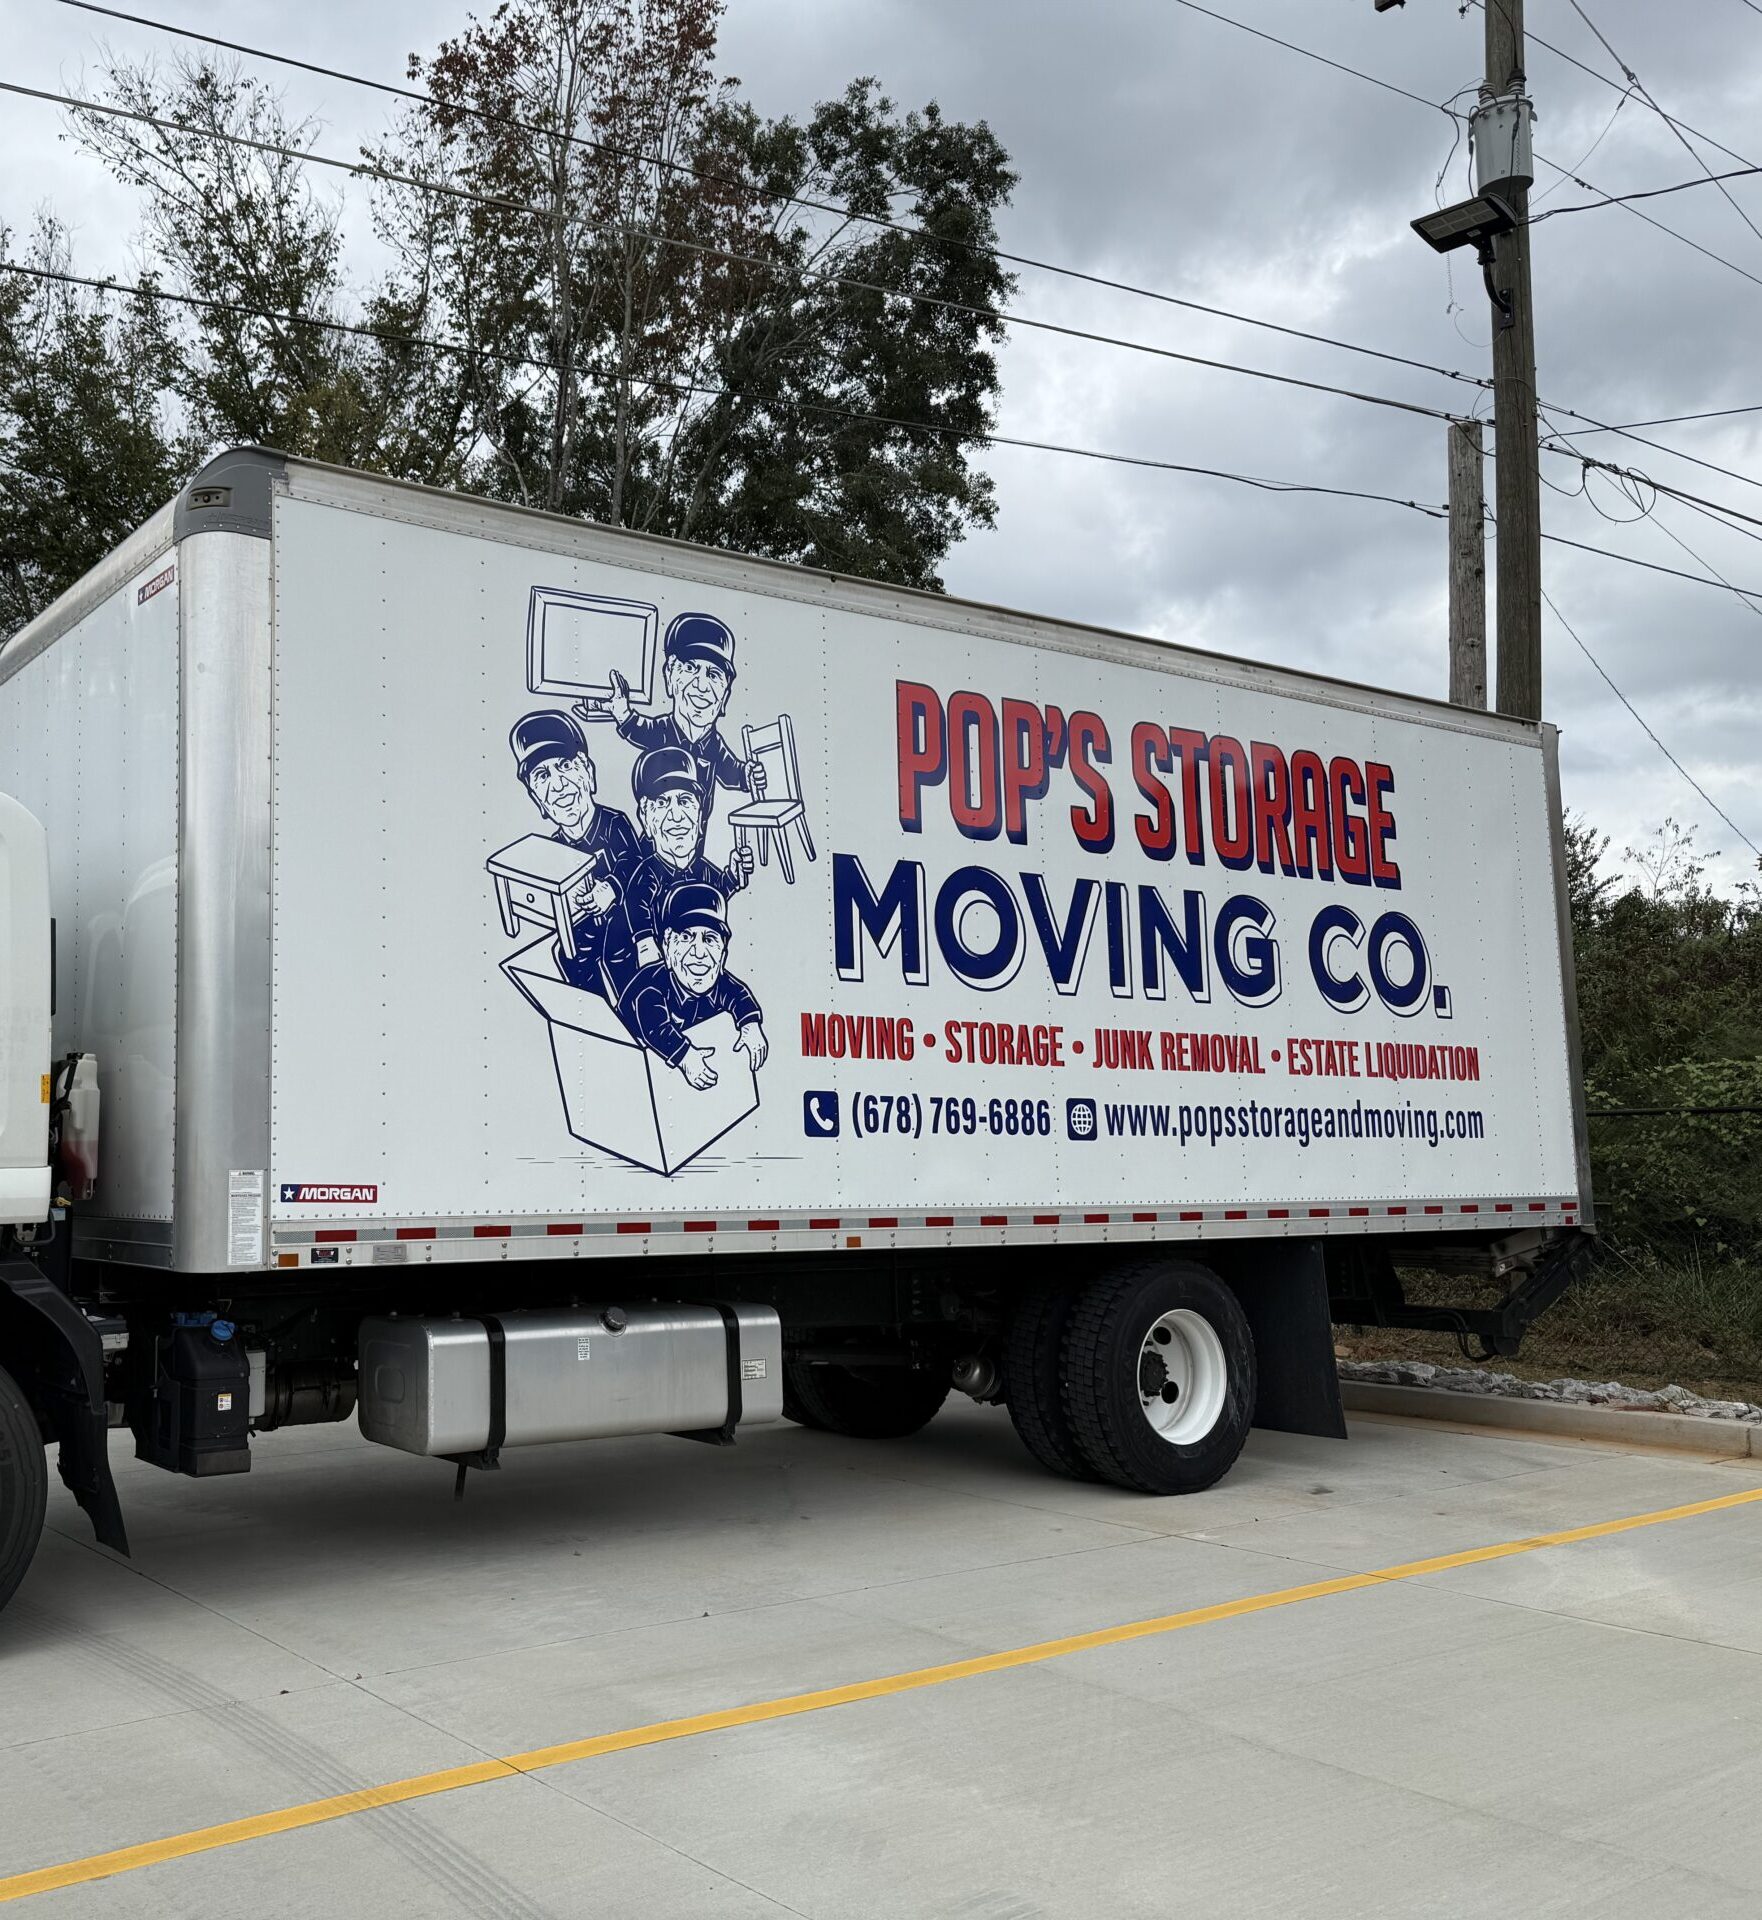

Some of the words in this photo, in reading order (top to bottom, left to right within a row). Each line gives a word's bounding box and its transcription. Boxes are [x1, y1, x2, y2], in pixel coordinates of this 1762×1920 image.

[144, 568, 174, 600] MORGAN
[896, 679, 1115, 855] POP'S
[1131, 721, 1402, 891] STORAGE
[832, 852, 1282, 1009] MOVING
[1308, 904, 1453, 1020] CO.
[800, 1012, 914, 1061] MOVING
[944, 1020, 1065, 1067] STORAGE
[1092, 1028, 1155, 1070] JUNK
[1160, 1031, 1265, 1074] REMOVAL
[1286, 1037, 1361, 1077] ESTATE
[1364, 1040, 1480, 1082] LIQUIDATION
[852, 1092, 922, 1139] (678)
[929, 1096, 1051, 1136] 769-6886
[1104, 1099, 1485, 1147] www.popsstorageandmoving.com
[299, 1186, 374, 1201] MORGAN
